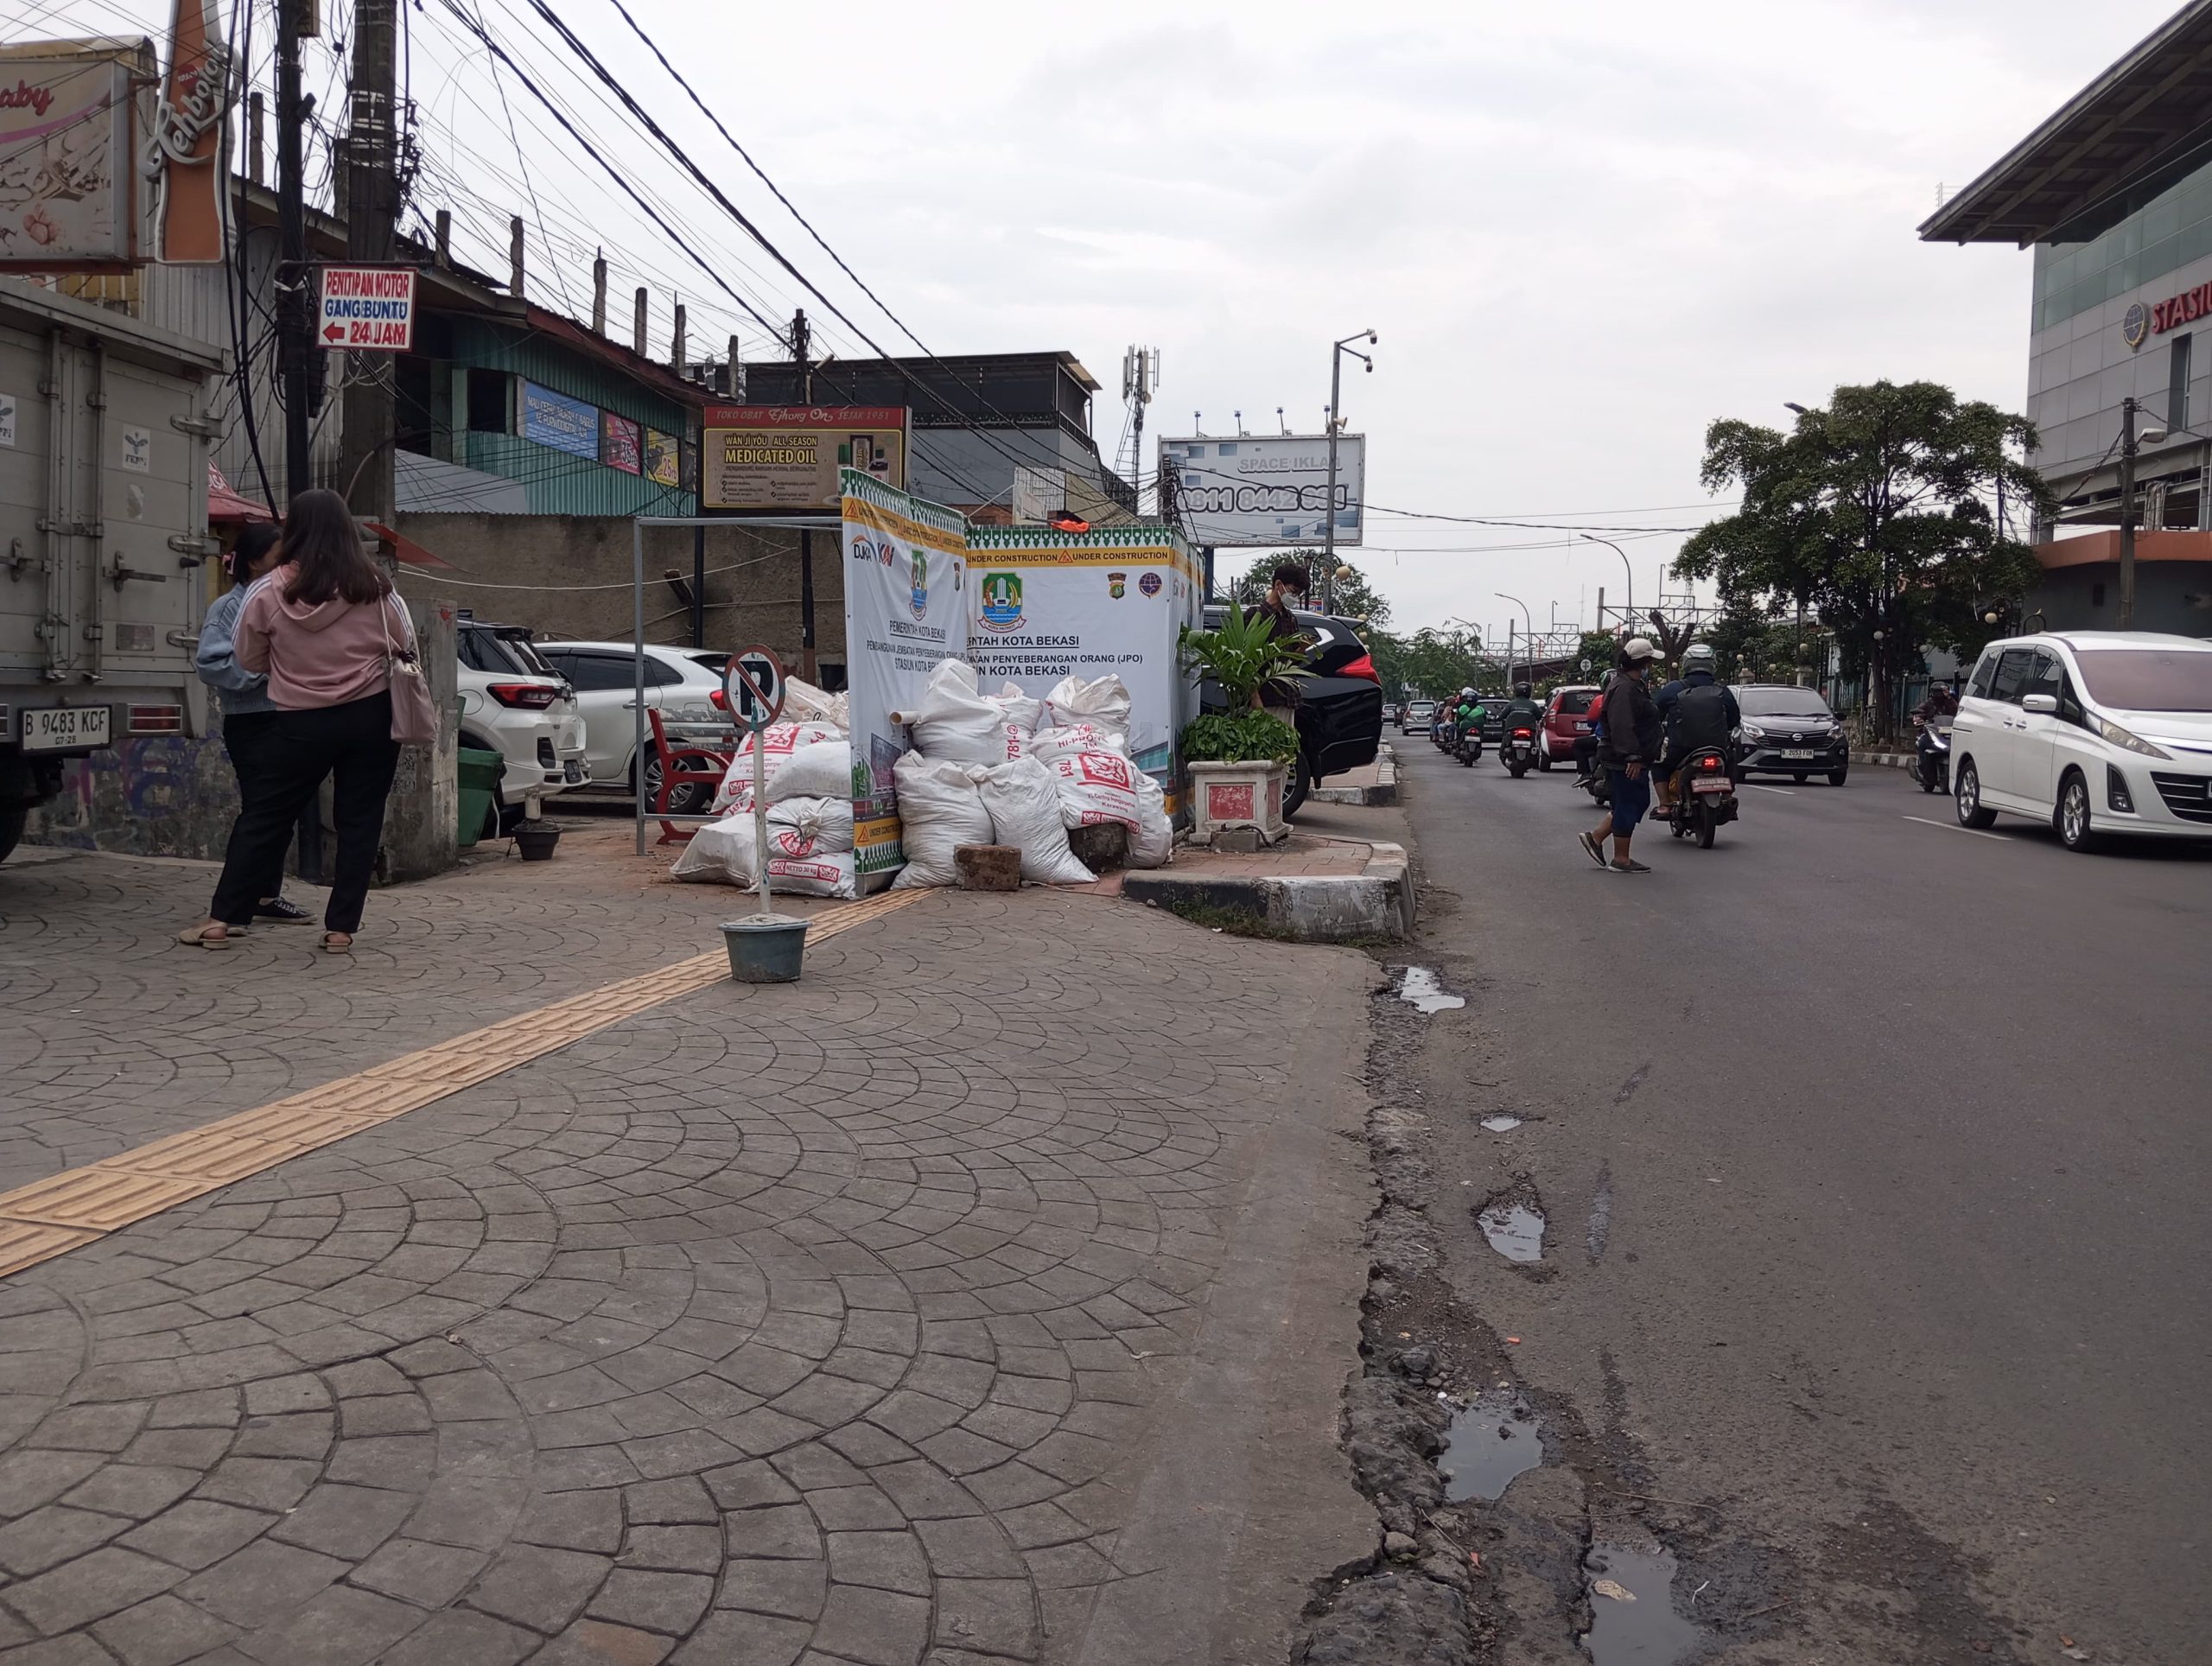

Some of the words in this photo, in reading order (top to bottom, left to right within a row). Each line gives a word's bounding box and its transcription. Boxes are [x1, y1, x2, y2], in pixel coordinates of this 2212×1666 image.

[326, 270, 374, 296] PENITIPAN
[376, 272, 410, 298] MOTOR
[325, 298, 360, 319] GANG
[364, 300, 408, 320] BUNTU
[350, 321, 370, 344] 24
[373, 322, 407, 346] JAM
[716, 410, 739, 420] TOKO
[741, 410, 764, 420] OBAT
[838, 410, 864, 420] SEJAK
[773, 436, 786, 446] ALL
[788, 436, 817, 446] SEASON
[725, 448, 794, 464] MEDICATED
[797, 448, 817, 464] OIL
[1239, 458, 1289, 470] SPACE
[1238, 486, 1297, 510] 8442
[994, 554, 1058, 563] CONSTRUCTION
[1072, 552, 1102, 562] UNDER
[1103, 551, 1168, 561] CONSTRUCTION
[889, 620, 918, 634] PEMERINTAH
[918, 625, 931, 638] KOTA
[1002, 636, 1033, 646] KOTA
[1036, 635, 1079, 646] BEKASI
[895, 658, 914, 671] STASIUN
[915, 660, 927, 672] KOTA
[992, 654, 1077, 664] PENYEBERANGAN
[1080, 654, 1115, 664] ORANG
[1117, 653, 1143, 664] (JPO)
[989, 665, 1022, 677] KOTA
[1026, 665, 1071, 677] BEKASI
[25, 714, 34, 735] B
[41, 711, 75, 734] 9483
[81, 710, 106, 733] KCF
[1058, 760, 1075, 778] 781
[786, 864, 803, 873] NETTO
[810, 866, 817, 875] kg
